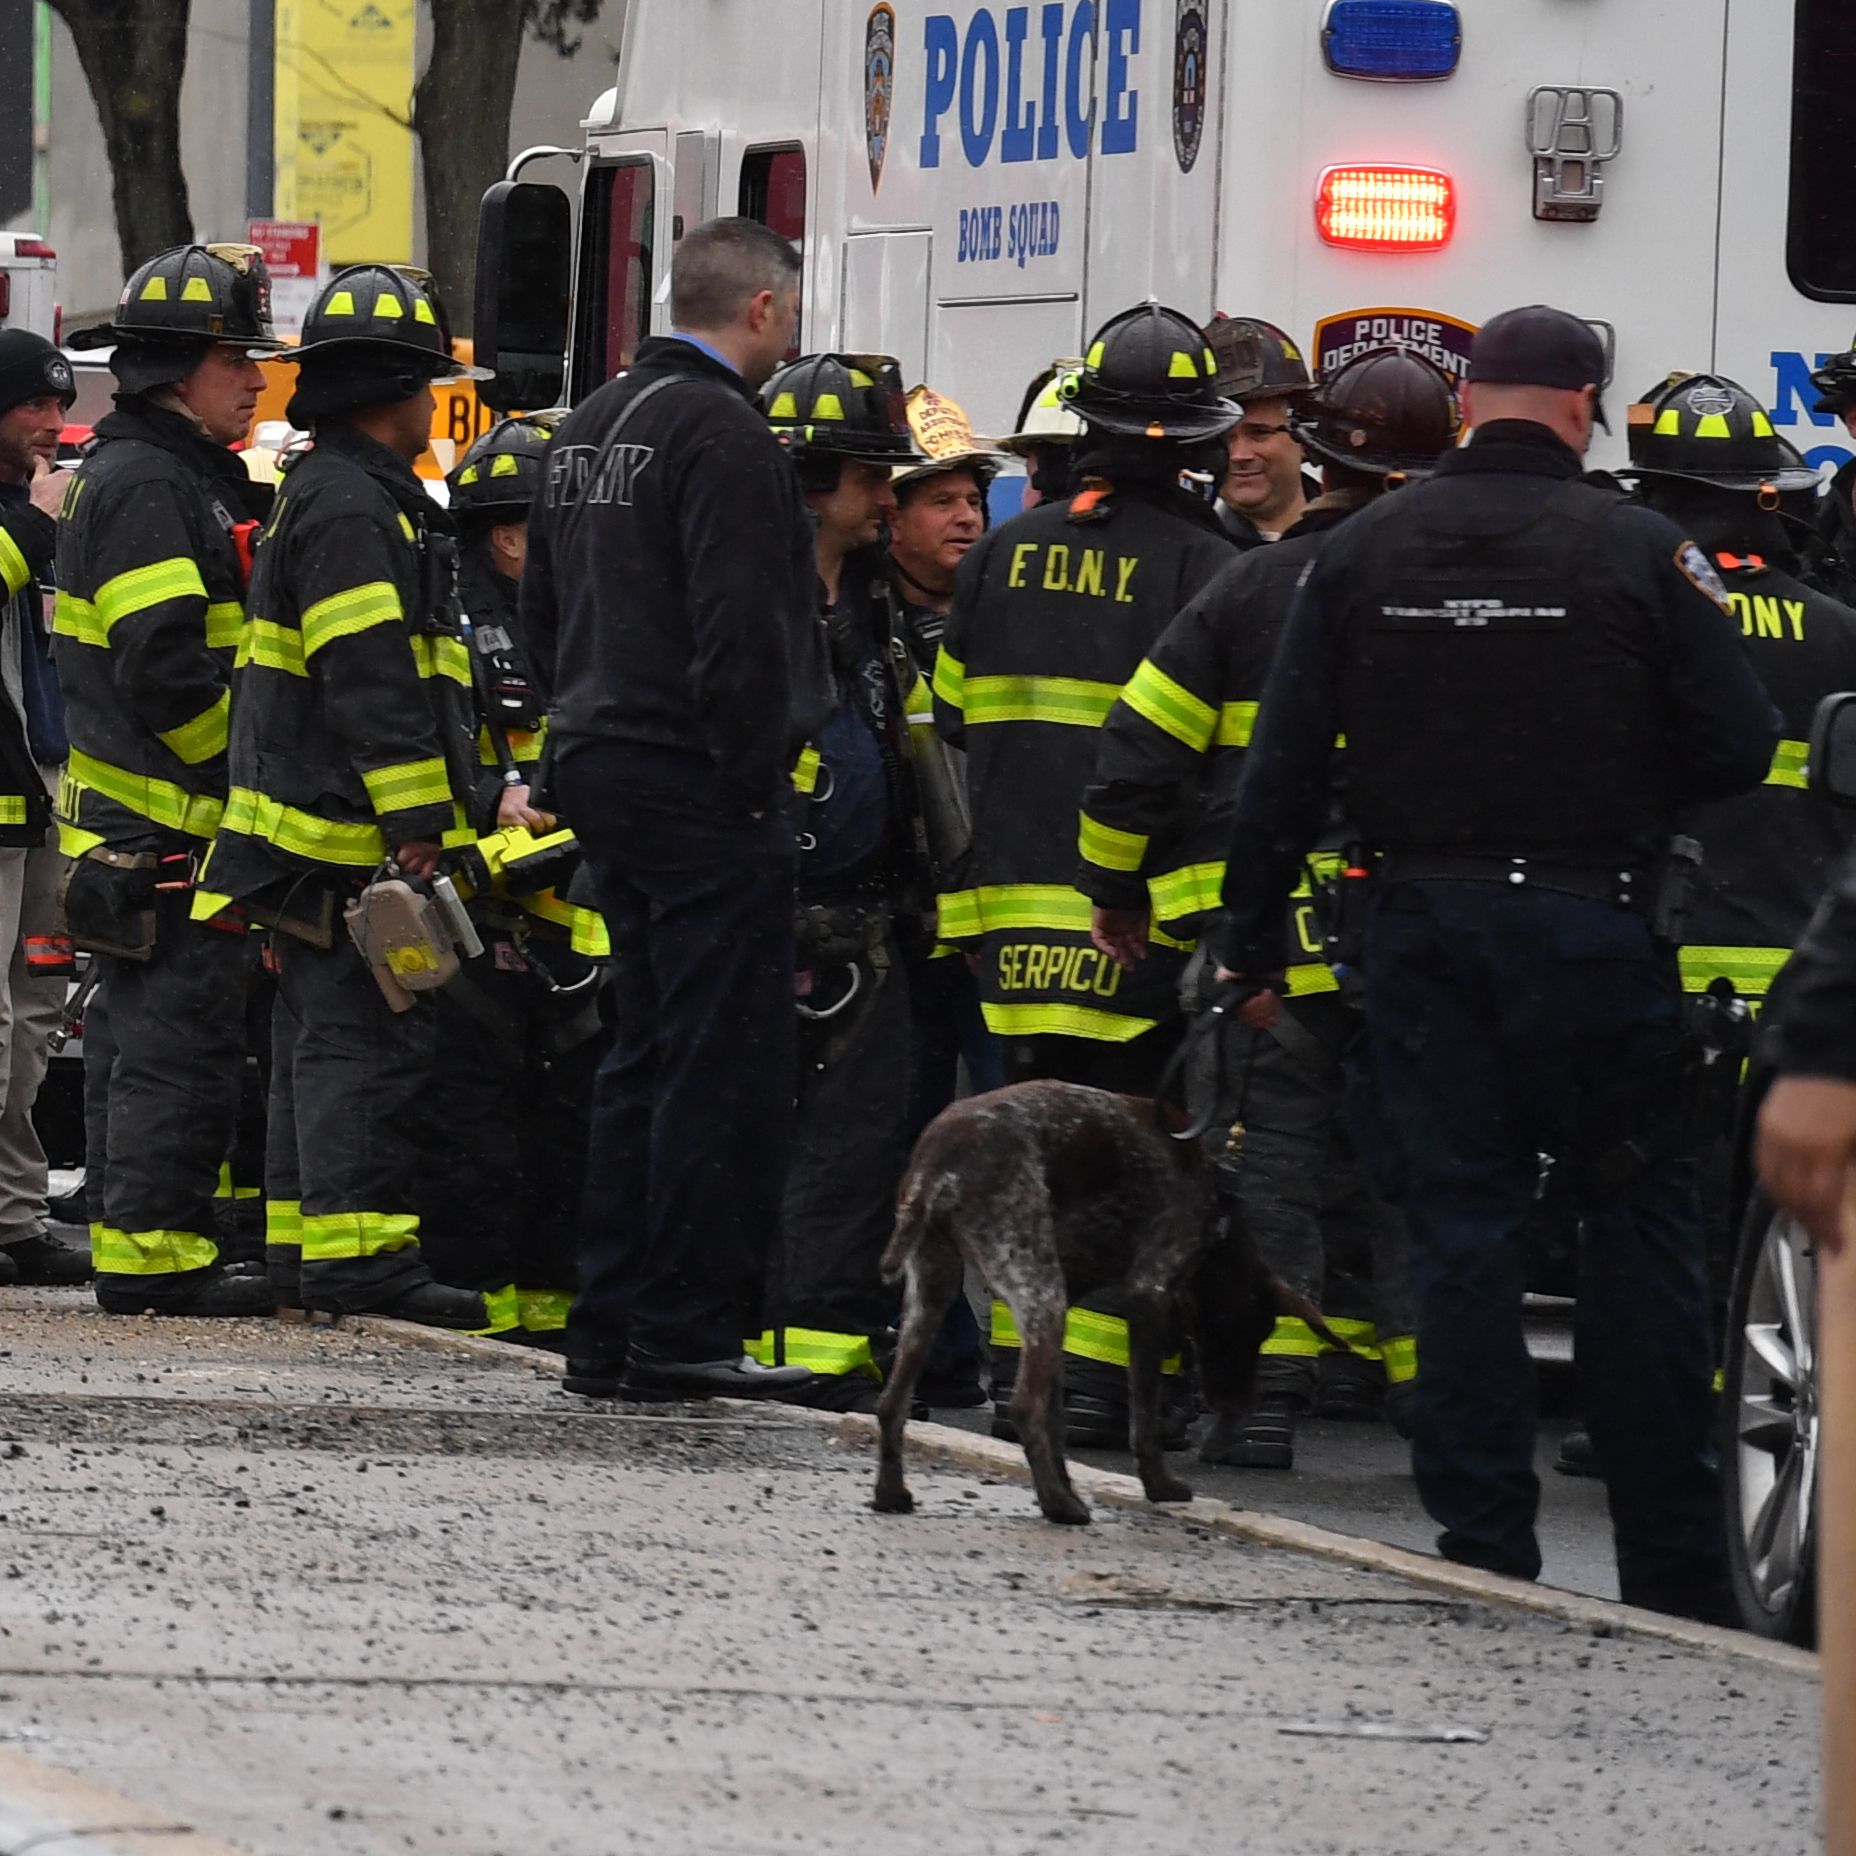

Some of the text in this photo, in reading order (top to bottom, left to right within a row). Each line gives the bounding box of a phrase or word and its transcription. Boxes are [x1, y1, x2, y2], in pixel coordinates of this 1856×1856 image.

[957, 200, 1061, 269] BOMB SQUAD
[1355, 317, 1443, 346] POLICE
[998, 943, 1123, 998] SERPICO
